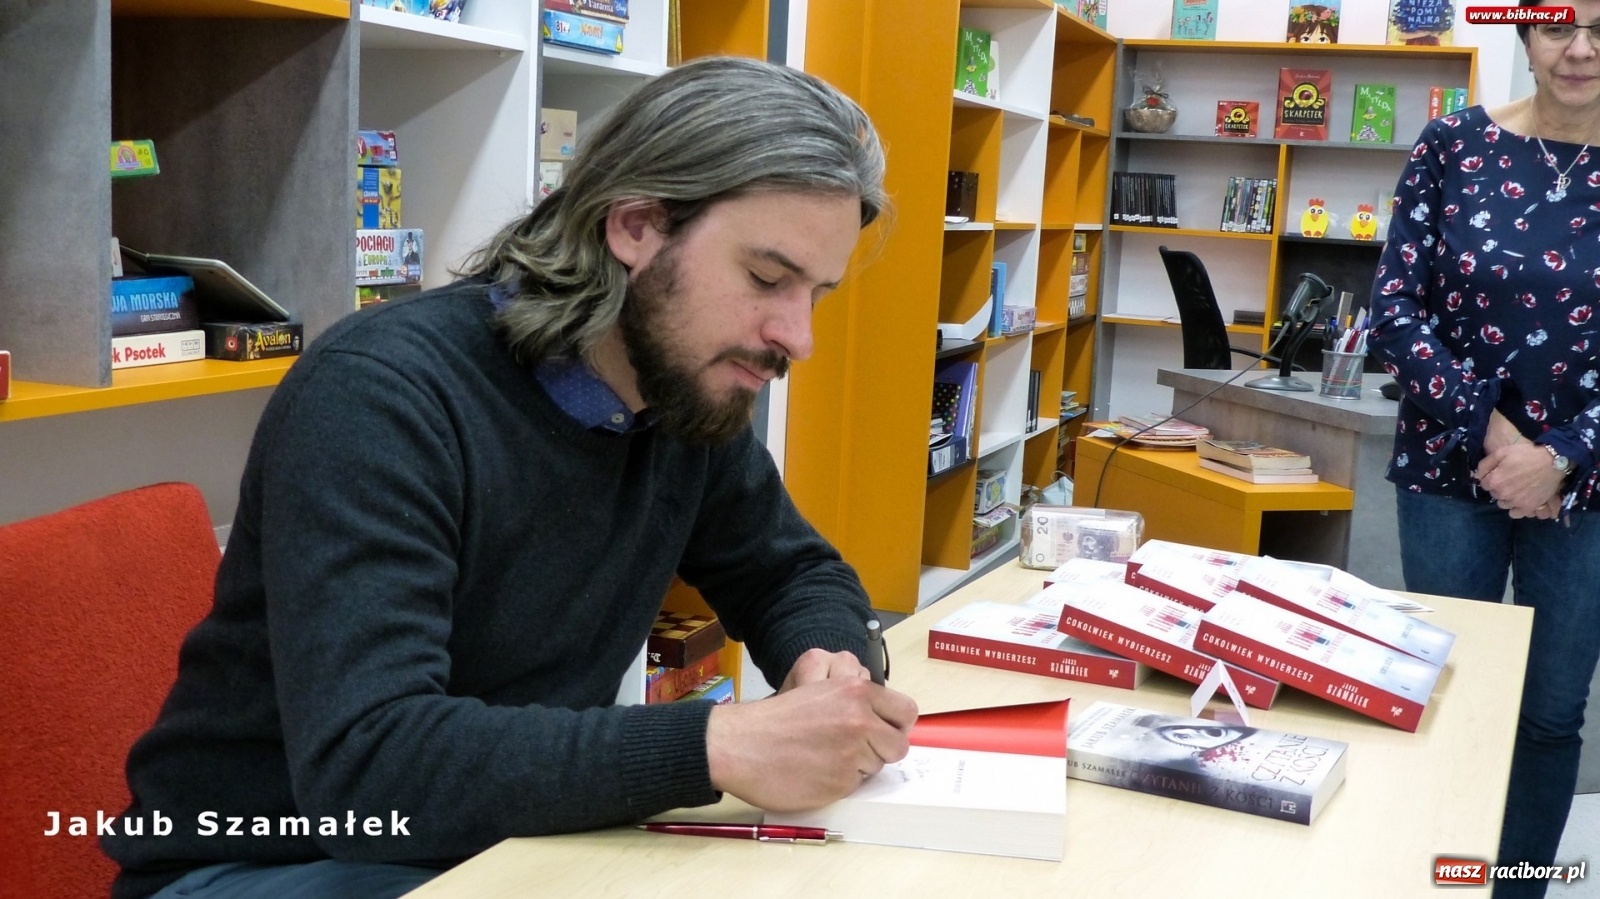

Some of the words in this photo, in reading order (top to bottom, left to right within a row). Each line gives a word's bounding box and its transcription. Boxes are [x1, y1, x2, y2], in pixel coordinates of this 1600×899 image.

[1360, 86, 1392, 112] MATYLDA
[1284, 109, 1323, 119] SKARPETEK
[363, 254, 389, 266] EUROPA
[130, 291, 179, 312] MORSKA
[124, 343, 166, 361] Psotek
[254, 330, 292, 352] Avalon
[1065, 616, 1115, 641] COKOLWIEK
[1117, 636, 1172, 663] WYBIERZESZ
[934, 641, 981, 656] COKOLWIEK
[984, 649, 1037, 666] WYBIERZESZ
[1202, 632, 1254, 659] COKOLWIEK
[1256, 653, 1314, 682] WYBIERZESZ
